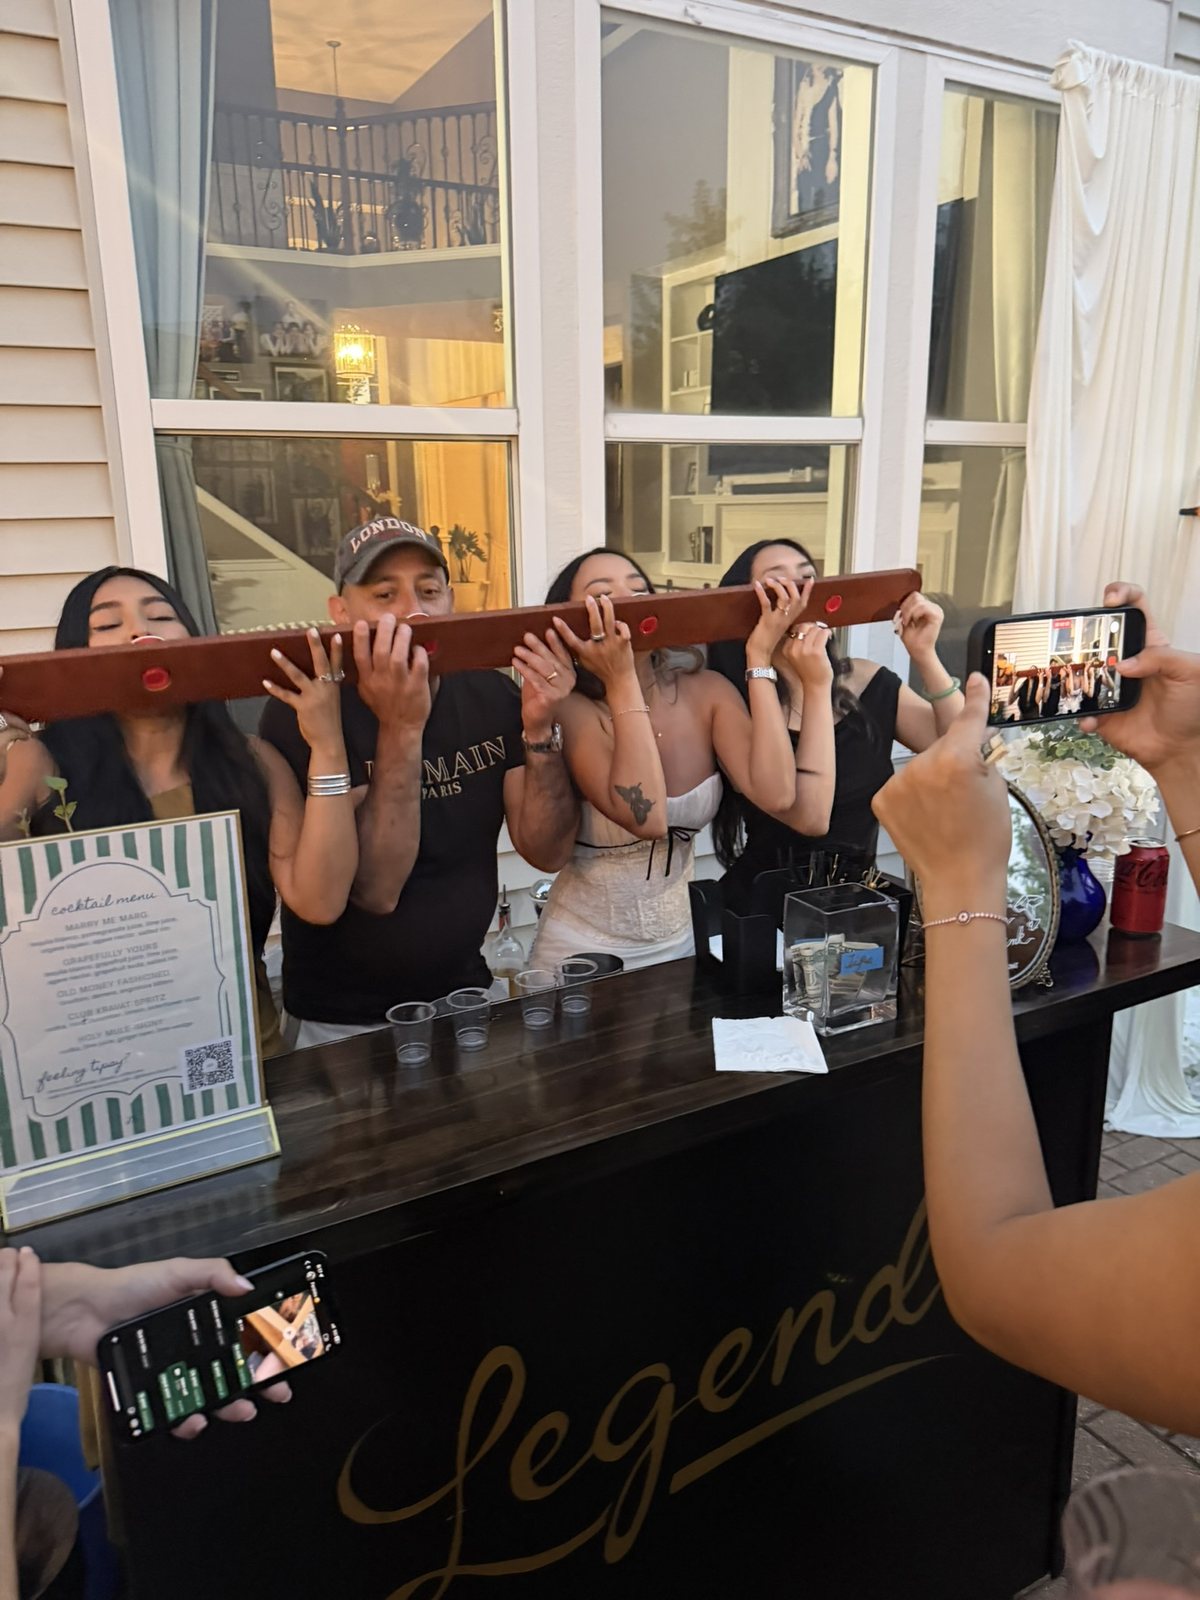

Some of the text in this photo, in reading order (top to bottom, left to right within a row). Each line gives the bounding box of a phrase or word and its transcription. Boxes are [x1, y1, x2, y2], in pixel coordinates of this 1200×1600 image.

[350, 518, 427, 554] LONDON
[365, 736, 507, 784] MAIN
[422, 781, 463, 800] PARIS
[51, 892, 158, 915] cocktail menu
[65, 918, 99, 932] MARRY
[102, 915, 116, 925] ME
[119, 911, 148, 922] MARG
[62, 949, 123, 966] GRAPEFULLY
[127, 942, 159, 955] YOURS
[56, 988, 77, 999] OLD
[79, 980, 115, 994] MONEY
[117, 969, 171, 986] FASHIONED
[67, 1009, 94, 1021] CLUB
[134, 993, 167, 1007] SPRITZ
[37, 1067, 86, 1093] feeling
